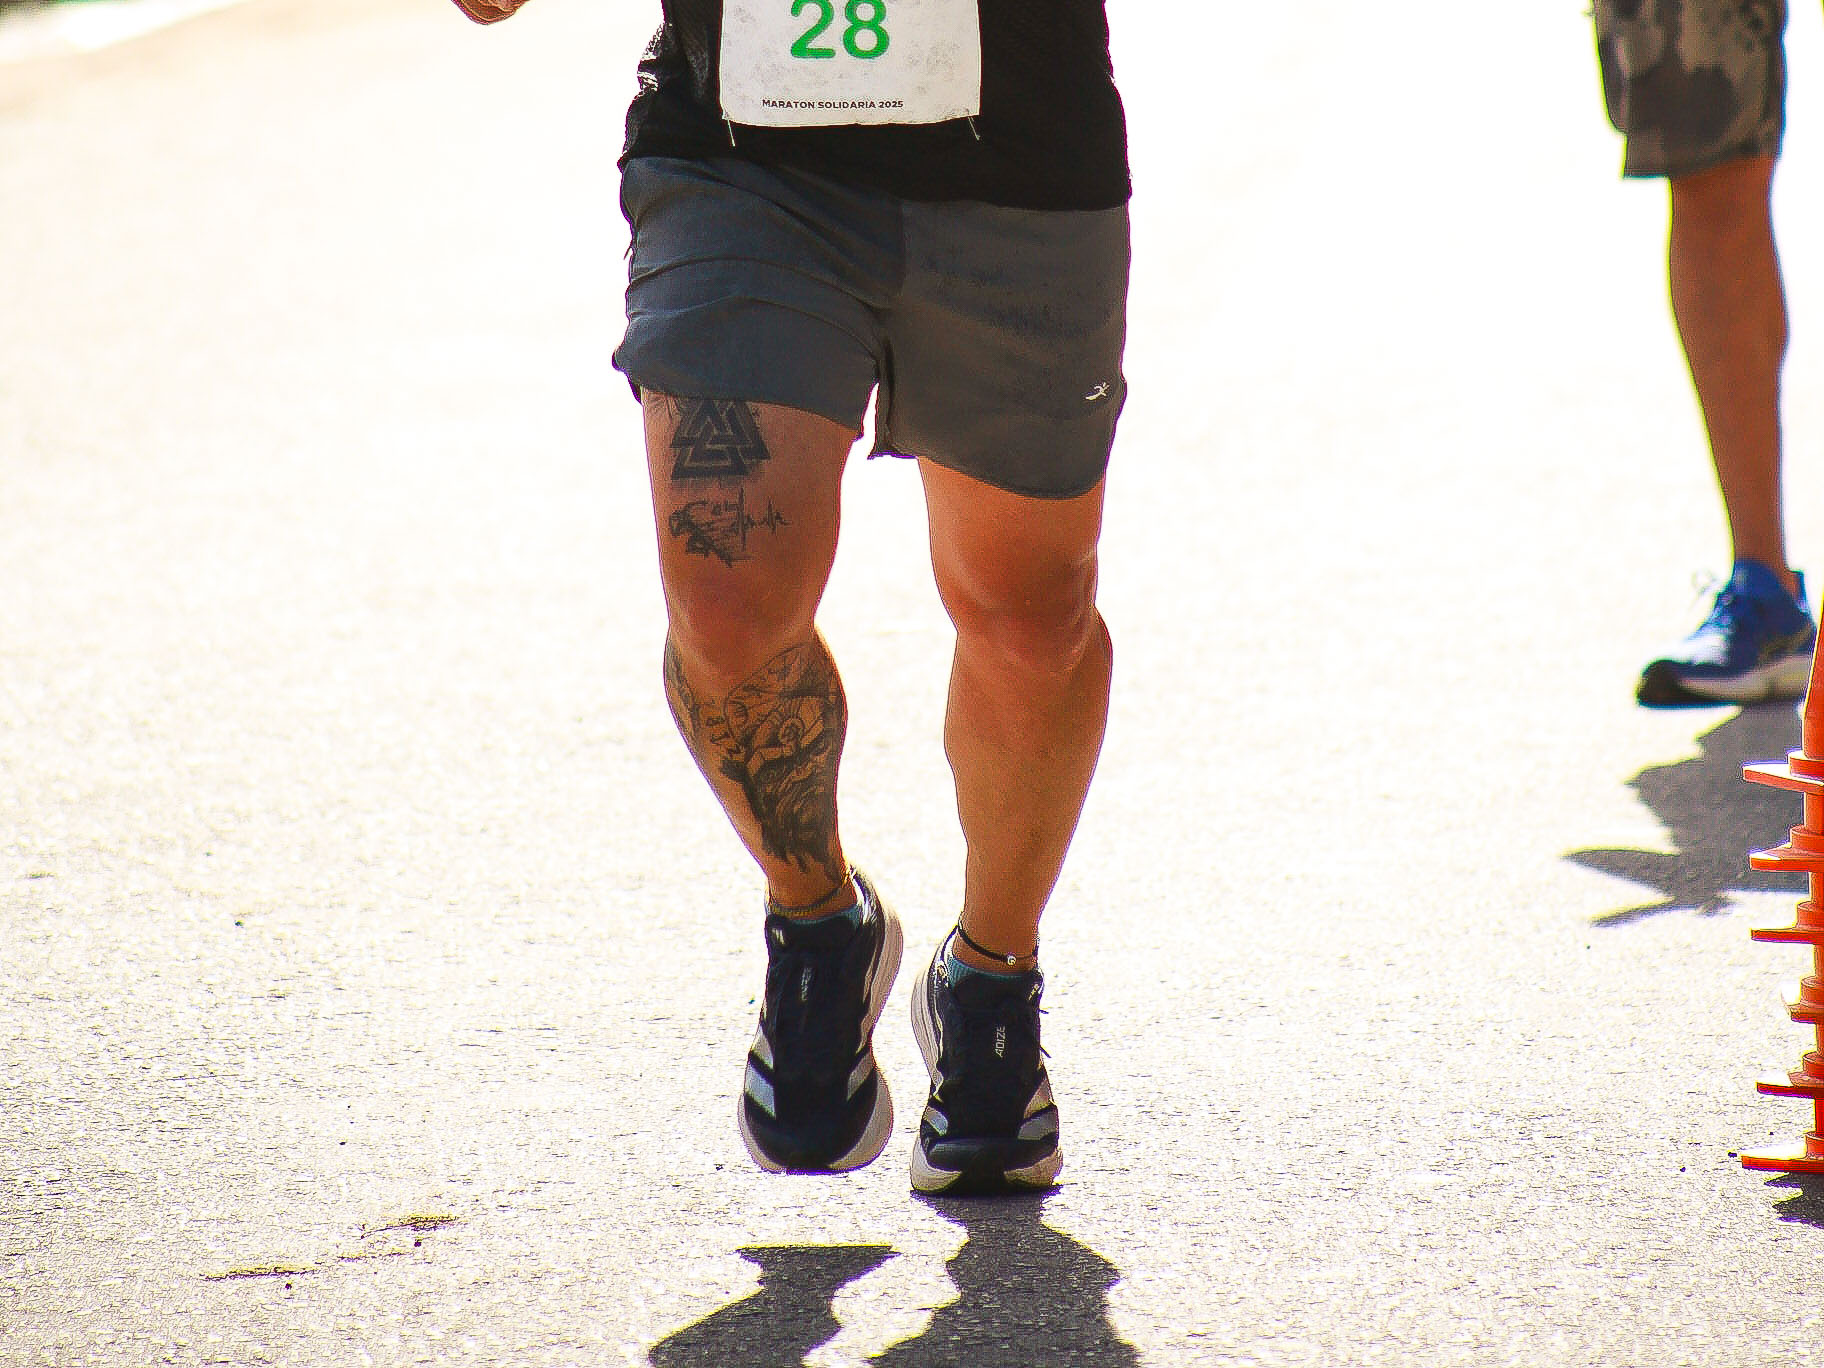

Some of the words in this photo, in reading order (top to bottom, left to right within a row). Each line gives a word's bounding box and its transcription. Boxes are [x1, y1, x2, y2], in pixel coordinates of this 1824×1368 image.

[762, 99, 815, 109] MARATON
[818, 100, 876, 109] SOLIDARIA
[878, 100, 904, 108] 2025
